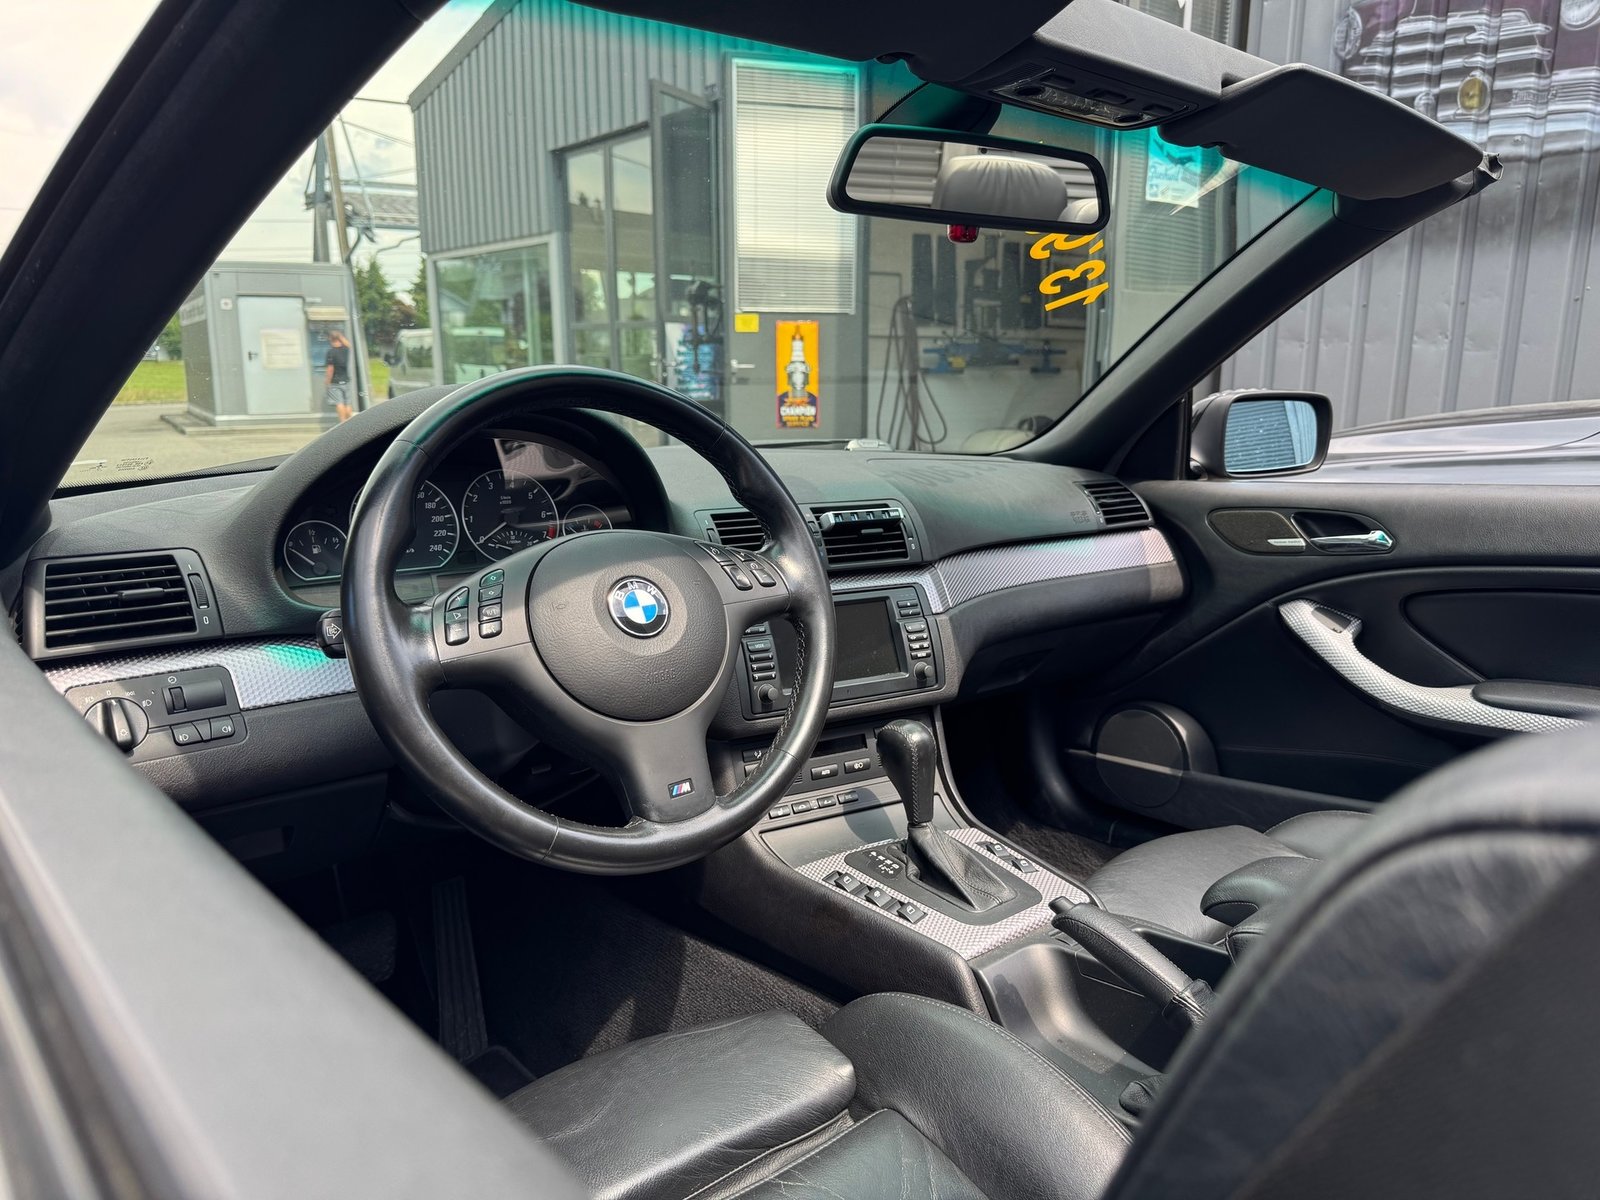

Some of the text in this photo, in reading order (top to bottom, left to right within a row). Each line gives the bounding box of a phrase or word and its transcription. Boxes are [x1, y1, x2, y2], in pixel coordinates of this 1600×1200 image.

[488, 482, 494, 490] 3
[472, 494, 478, 502] 2
[528, 492, 533, 500] 5
[424, 501, 437, 509] 180
[540, 510, 546, 518] 6
[431, 515, 445, 523] 200
[433, 529, 447, 537] 220
[429, 544, 443, 552] 240
[614, 581, 657, 600] BMW
